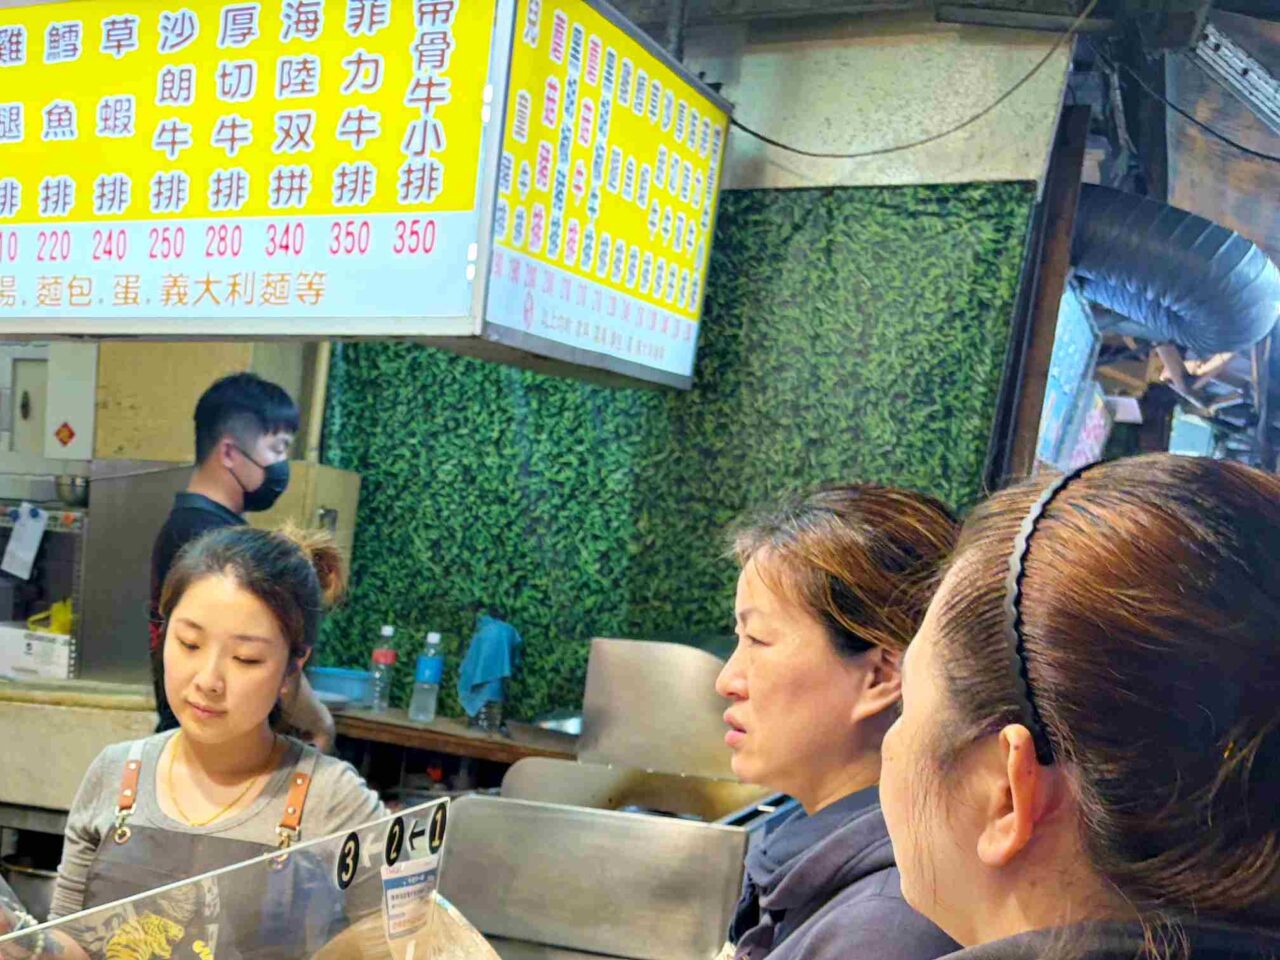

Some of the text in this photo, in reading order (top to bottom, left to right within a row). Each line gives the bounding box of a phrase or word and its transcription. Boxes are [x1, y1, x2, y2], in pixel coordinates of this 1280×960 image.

[41, 23, 79, 213] 鱈魚排
[96, 18, 137, 211] 草蝦排
[154, 12, 195, 210] 沙朗牛排
[212, 6, 257, 208] 厚切牛排
[36, 230, 71, 261] 220
[92, 229, 128, 260] 240
[149, 226, 185, 259] 250
[205, 224, 242, 258] 280
[265, 222, 304, 256] 340
[329, 220, 370, 254] 350
[393, 219, 435, 254] 350
